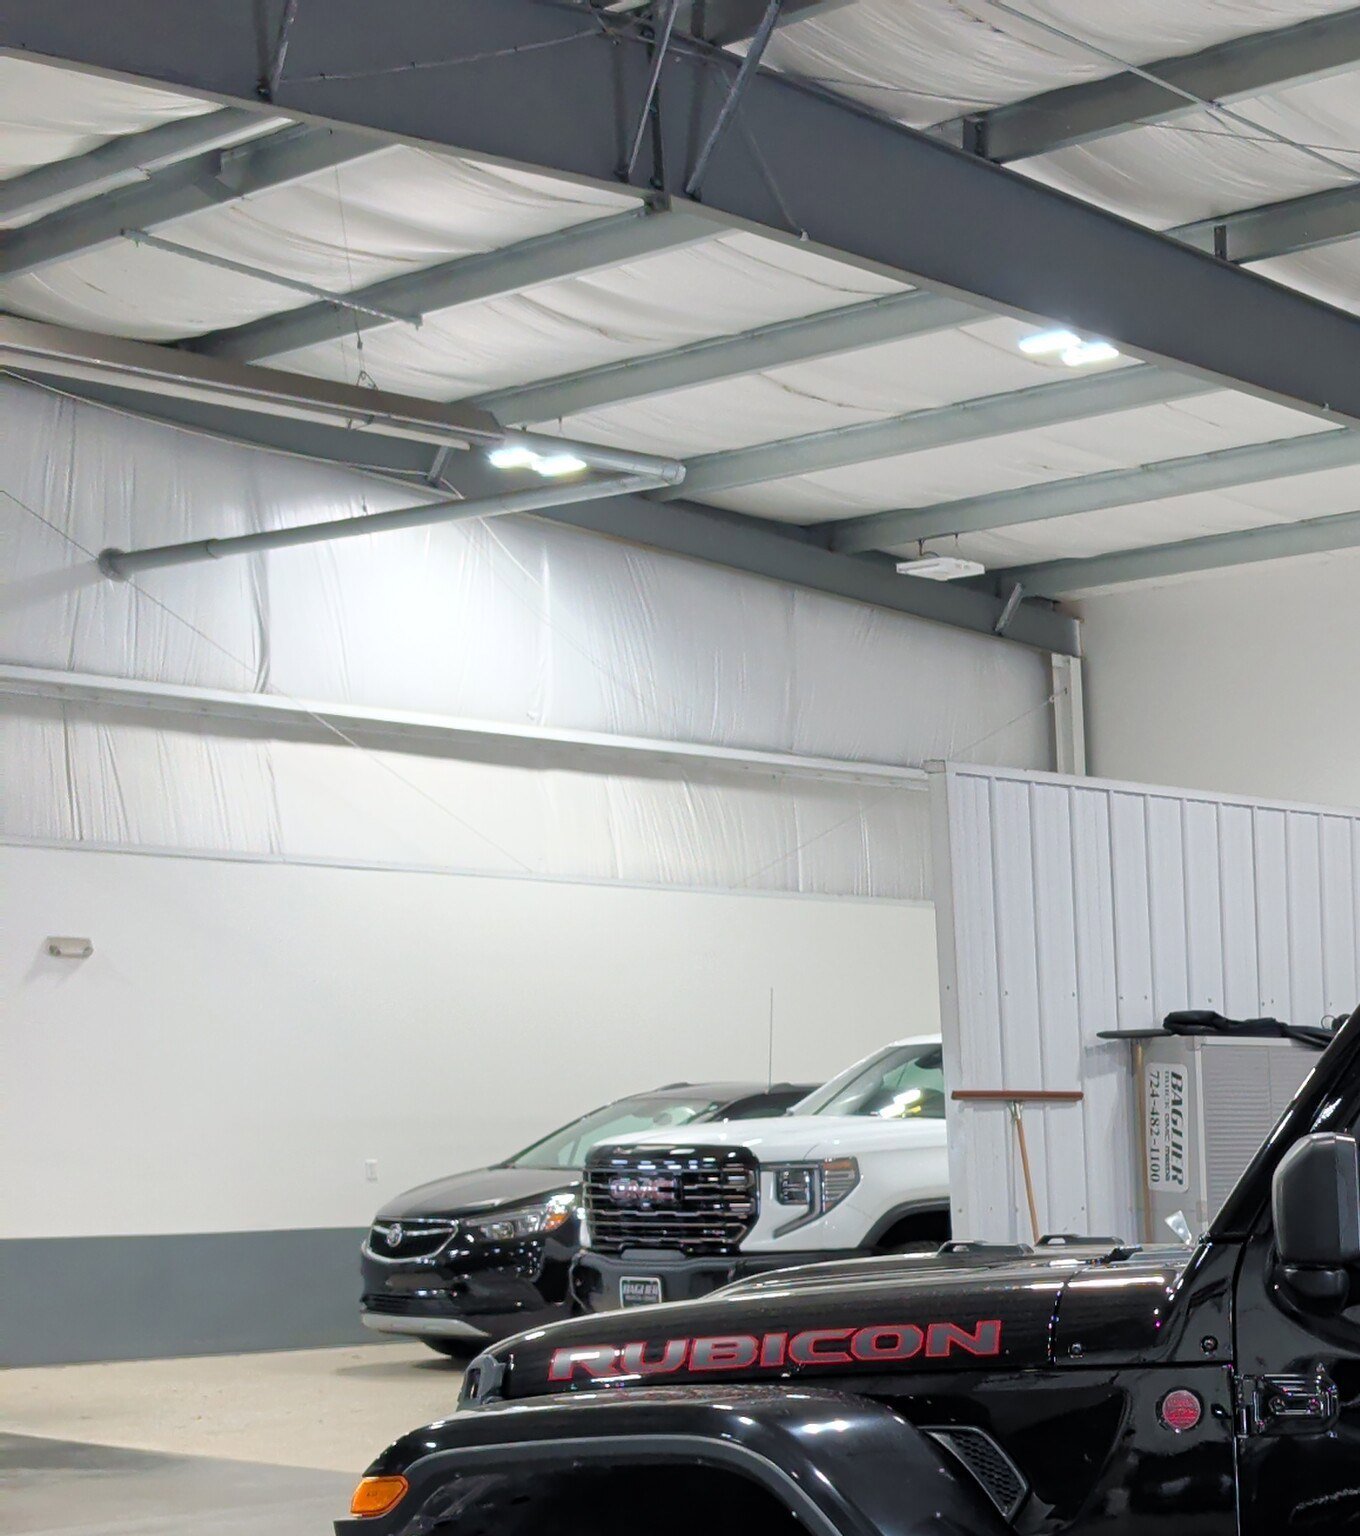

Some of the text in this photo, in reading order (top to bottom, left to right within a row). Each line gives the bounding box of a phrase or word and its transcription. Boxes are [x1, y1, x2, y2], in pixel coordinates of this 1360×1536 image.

[1149, 1070, 1160, 1182] 724-482-1100
[1171, 1071, 1183, 1185] BAGLIER
[548, 1320, 1002, 1381] RUBICON
